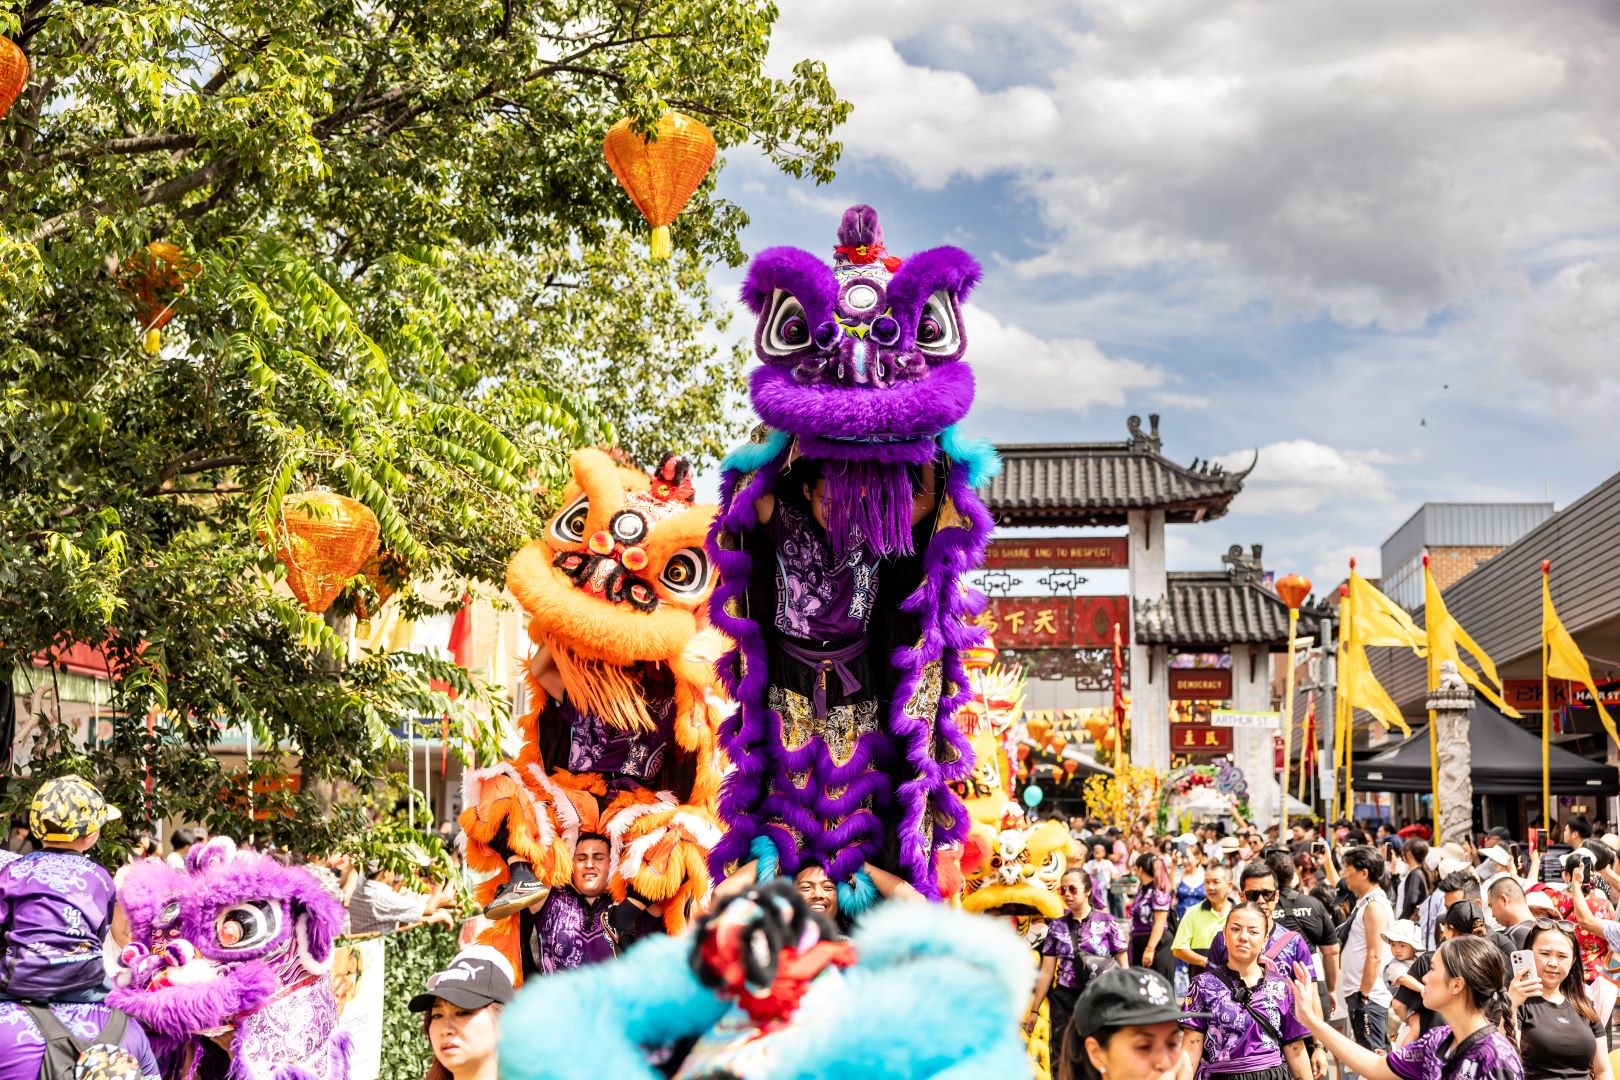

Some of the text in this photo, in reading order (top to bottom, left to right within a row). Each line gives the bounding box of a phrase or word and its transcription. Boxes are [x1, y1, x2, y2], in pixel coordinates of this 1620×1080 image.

[1001, 548, 1030, 559] SHARE
[1035, 547, 1051, 558] AND
[1056, 547, 1068, 558] TO
[1070, 547, 1111, 558] RESPECT
[1177, 680, 1223, 690] DEMOCRACY
[1575, 690, 1606, 701] HAR
[1215, 714, 1268, 726] ARTHUR ST
[1271, 907, 1312, 919] ECRITY
